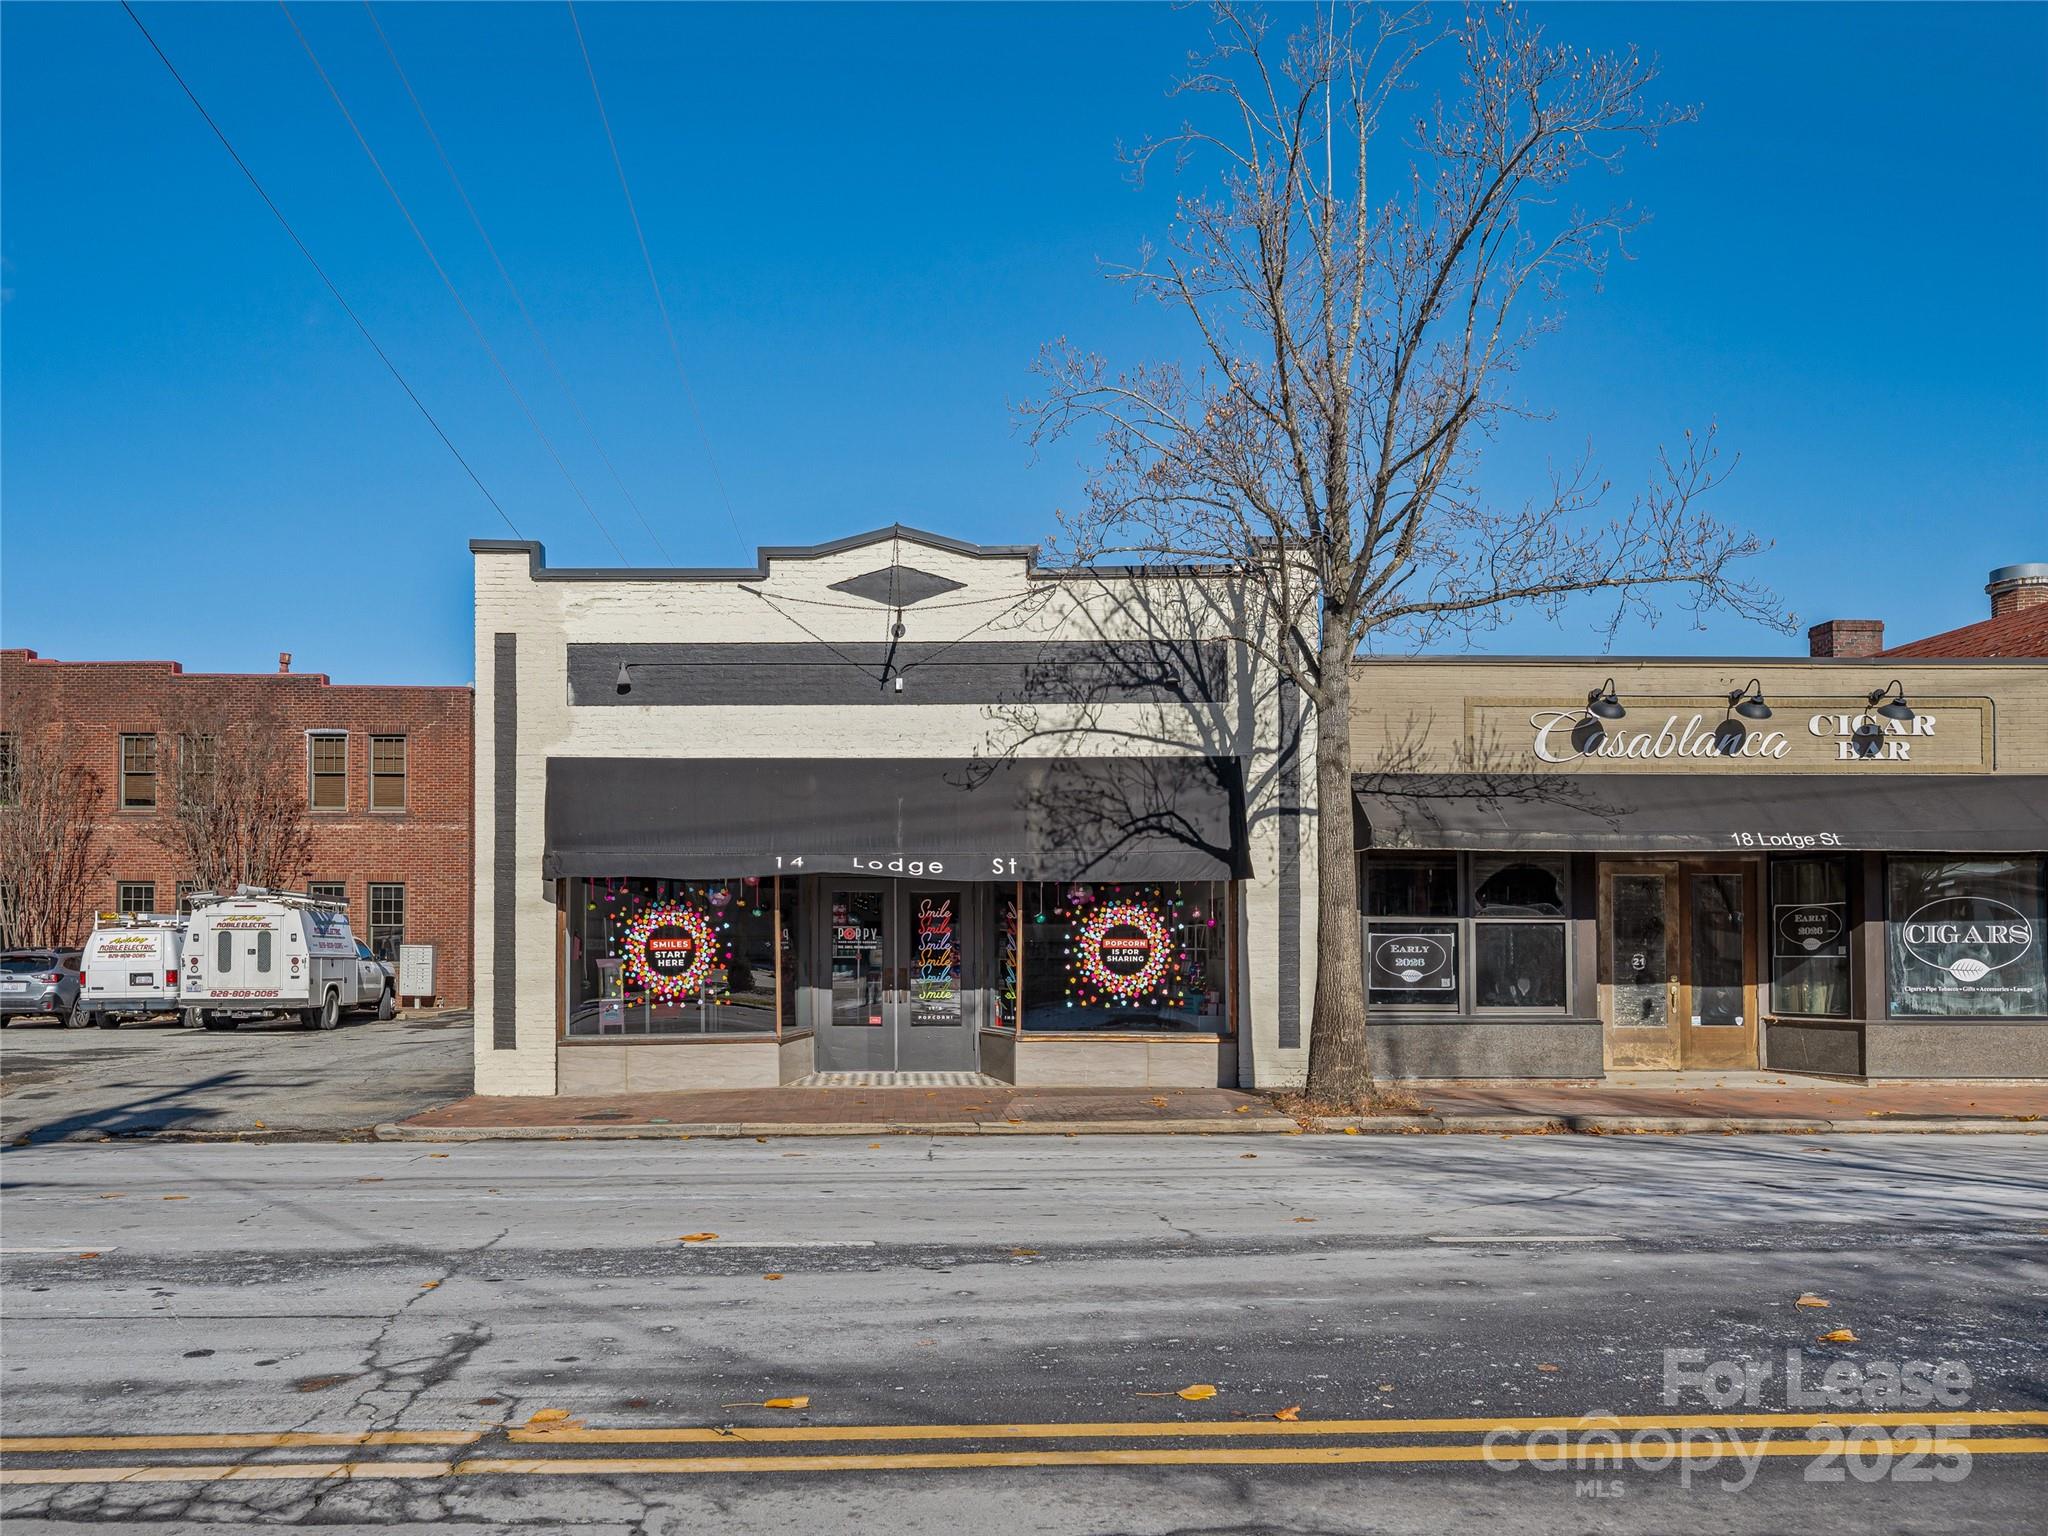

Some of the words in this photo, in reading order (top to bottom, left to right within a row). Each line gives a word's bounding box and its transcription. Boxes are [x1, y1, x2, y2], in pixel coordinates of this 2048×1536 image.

[1808, 714, 1936, 737] CIGAR
[1530, 709, 1792, 763] Casablanca
[1834, 741, 1911, 760] BAR
[1731, 832, 1754, 847] 18
[1757, 832, 1815, 849] Lodge
[1819, 832, 1842, 846] St
[775, 856, 804, 869] 14
[853, 857, 944, 876] Lodge
[991, 857, 1018, 875] St
[918, 899, 952, 918] Smile
[918, 915, 952, 934] Smile
[1905, 924, 2030, 944] CIGARS
[918, 932, 952, 950] Smile
[1390, 944, 1430, 953] EARLY
[658, 959, 685, 967] HERE
[918, 948, 952, 967] Smile
[918, 965, 952, 984] Smile
[210, 990, 279, 998] 828-808-0085
[919, 981, 952, 1000] Smile
